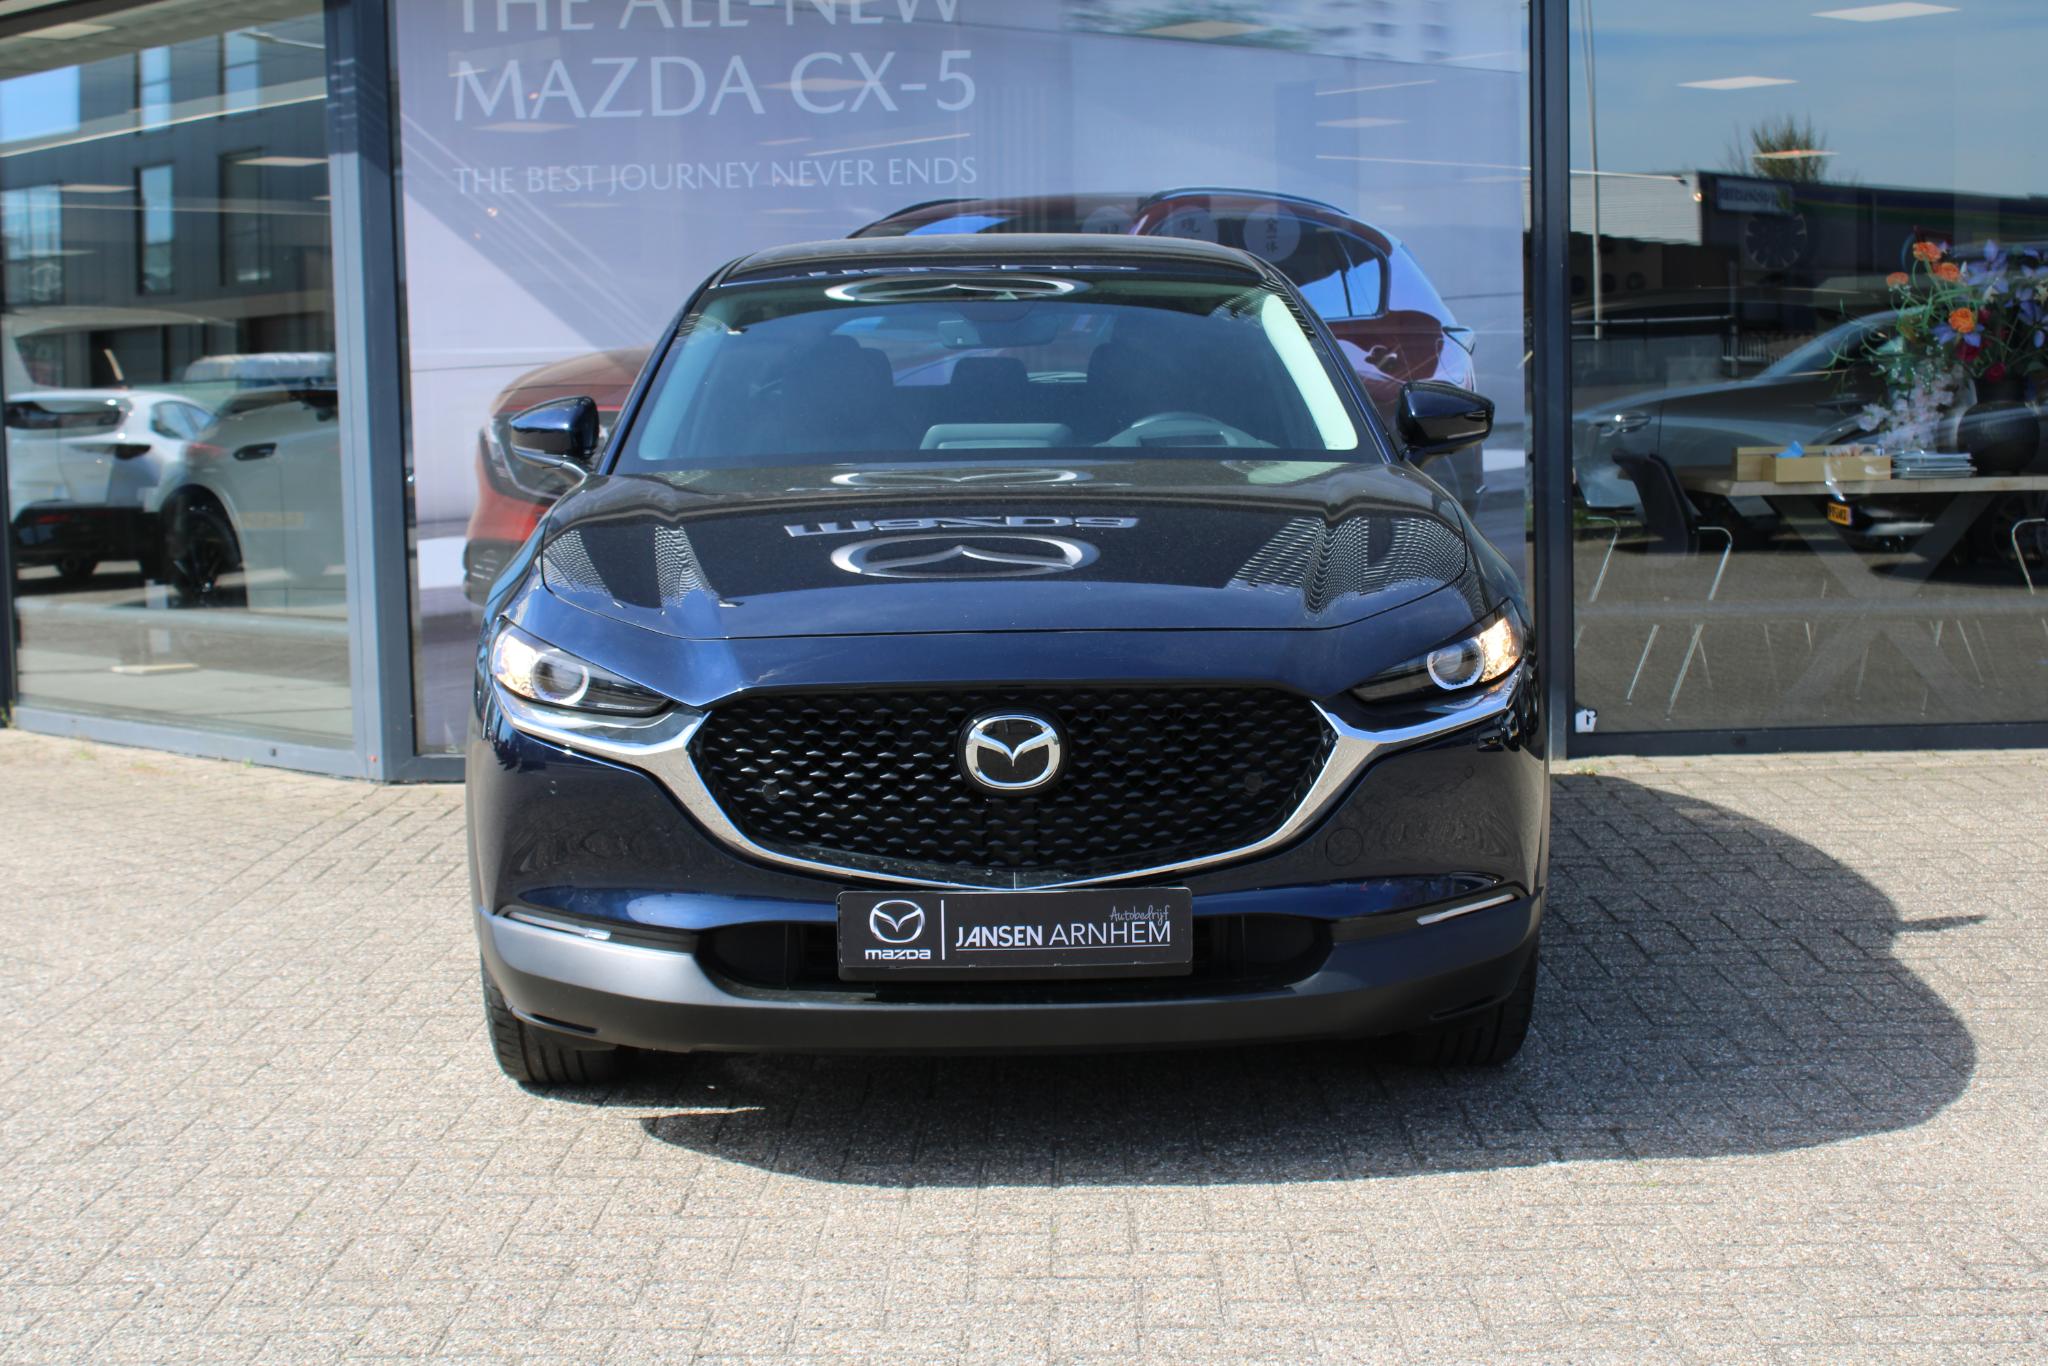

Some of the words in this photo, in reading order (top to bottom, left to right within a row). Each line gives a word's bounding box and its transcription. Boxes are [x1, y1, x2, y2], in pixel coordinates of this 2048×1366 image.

[454, 54, 766, 122] MAZDA
[790, 49, 976, 114] CX-5
[453, 165, 516, 195] THE
[527, 164, 599, 193] BEST
[607, 161, 761, 197] JOURNEY
[770, 158, 879, 188] NEVER
[888, 156, 977, 185] ENDS
[1109, 904, 1171, 926] Autobedrijf
[955, 925, 1043, 948] JANSEN
[1049, 920, 1171, 946] ARNHEM
[864, 948, 931, 960] mazda
